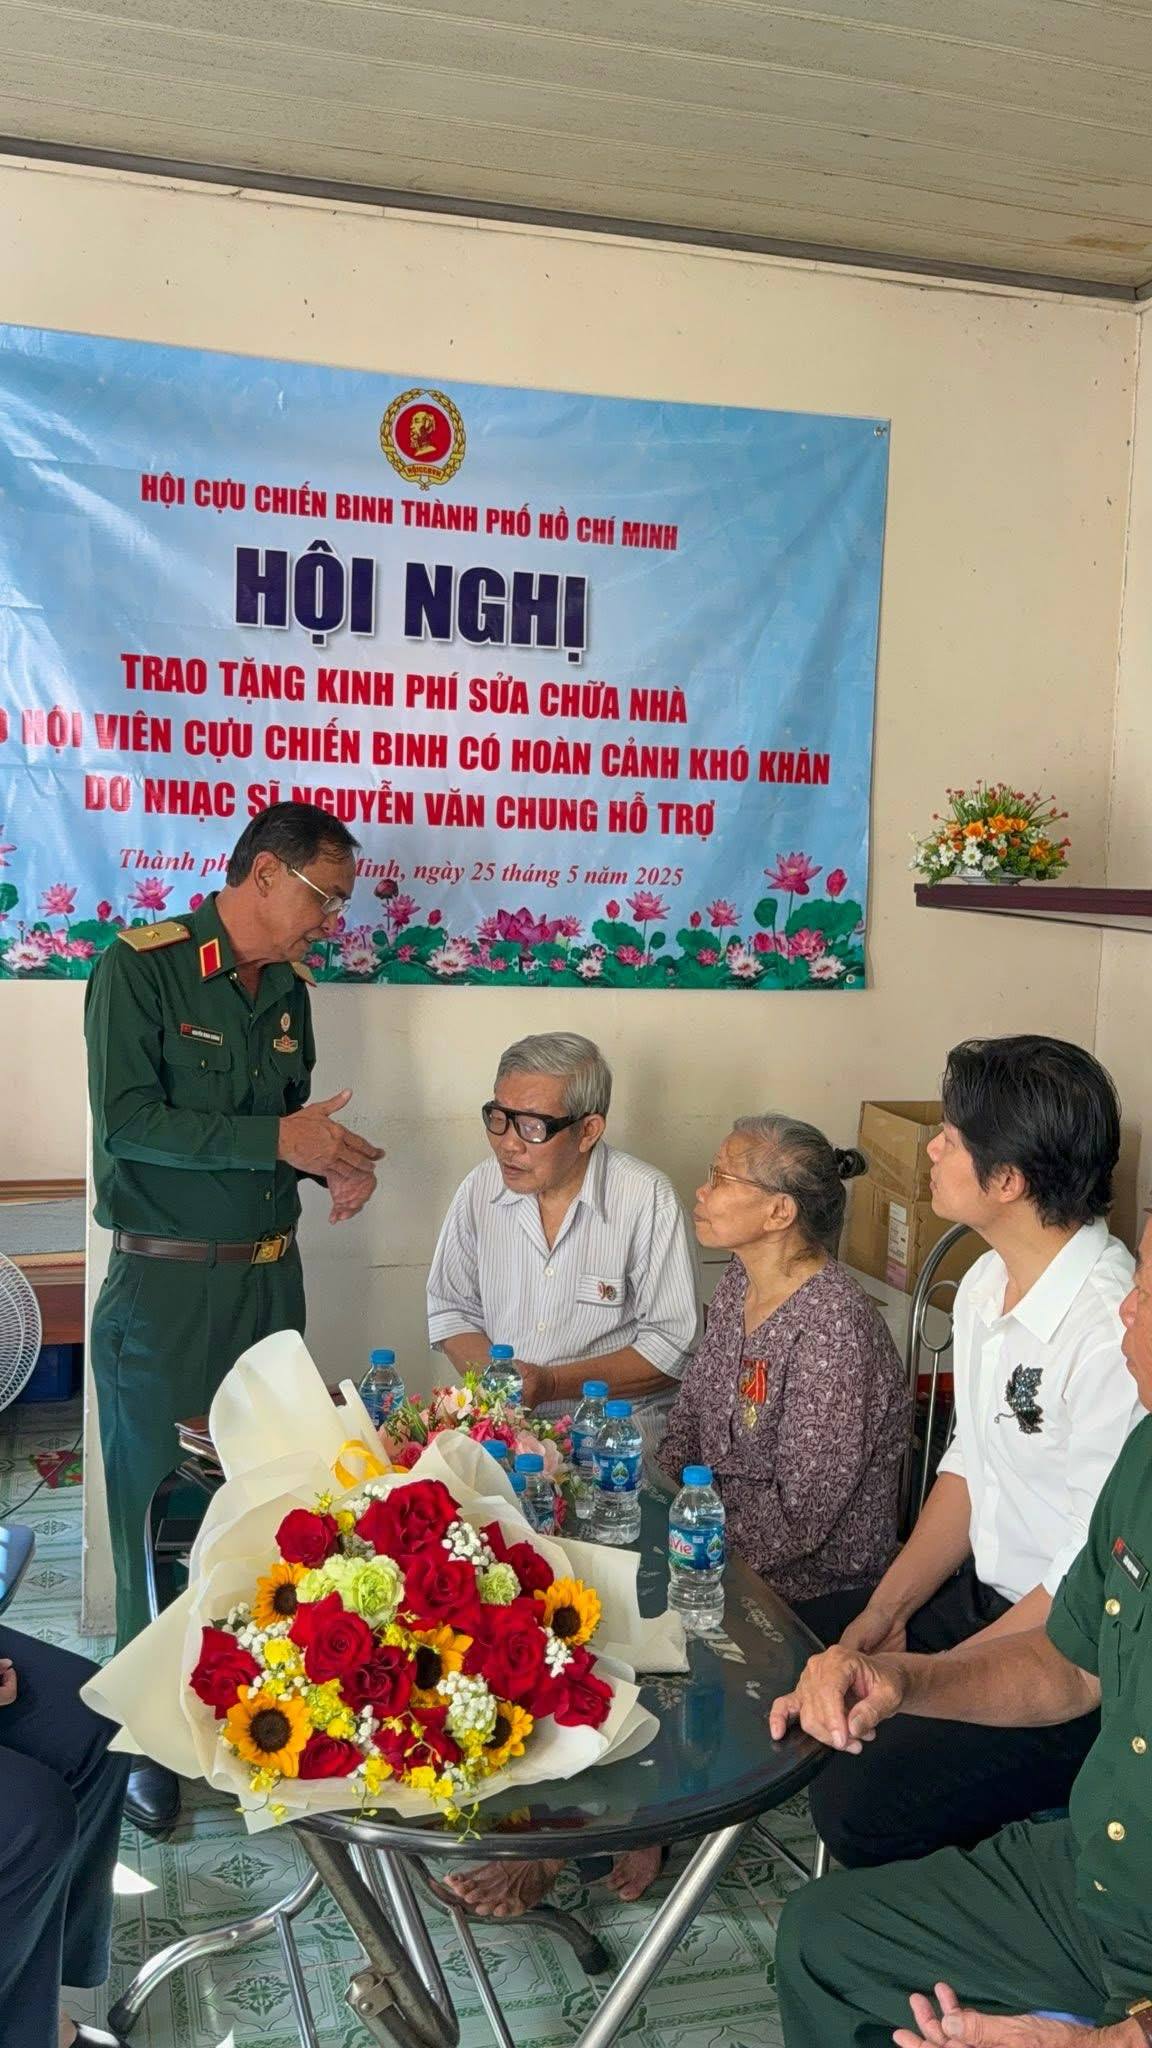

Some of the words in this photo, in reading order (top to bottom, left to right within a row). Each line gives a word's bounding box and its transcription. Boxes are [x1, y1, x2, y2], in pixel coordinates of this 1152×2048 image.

[140, 472, 185, 508] HỘI
[194, 478, 246, 513] CỰU
[255, 481, 327, 518] CHIẾN
[336, 493, 393, 524] BINH
[401, 499, 478, 532] THÀNH
[485, 503, 531, 537] PHỐ
[538, 506, 569, 540] HỒ
[577, 515, 615, 545] CHÍ
[621, 520, 678, 550] MINH
[236, 539, 375, 645] HỘI
[404, 561, 587, 663] NGHỊ
[121, 653, 207, 696] TRAO
[219, 658, 305, 704] TẶNG
[317, 668, 394, 707] KINH
[405, 672, 458, 710] PHÍ
[468, 672, 530, 714] SỬA
[539, 680, 620, 720] CHỮA
[629, 685, 687, 723] NHÀ
[22, 704, 82, 753] HỘI
[94, 709, 172, 752] VIÊN
[184, 717, 253, 763] CỰU
[265, 717, 361, 765] CHIẾN
[371, 731, 448, 769] BINH
[458, 733, 501, 772] CÓ
[511, 736, 592, 776] HOÀN
[601, 737, 679, 779] CẢNH
[689, 746, 749, 781] KHÓ
[758, 747, 830, 785] KHĂN
[85, 775, 131, 812] DO
[144, 779, 235, 822] NHẠC
[247, 779, 280, 817] SĨ
[424, 787, 485, 827] VĂN
[495, 795, 598, 832] CHUNG
[608, 792, 648, 834] HỖ
[657, 800, 714, 841] TRỢ
[119, 848, 195, 871] Thành
[201, 852, 230, 878] ph
[413, 866, 464, 887] ngày
[471, 862, 495, 881] 25
[502, 864, 561, 888] tháng
[568, 865, 580, 884] 5
[584, 867, 631, 885] năm
[636, 867, 684, 886] 2025
